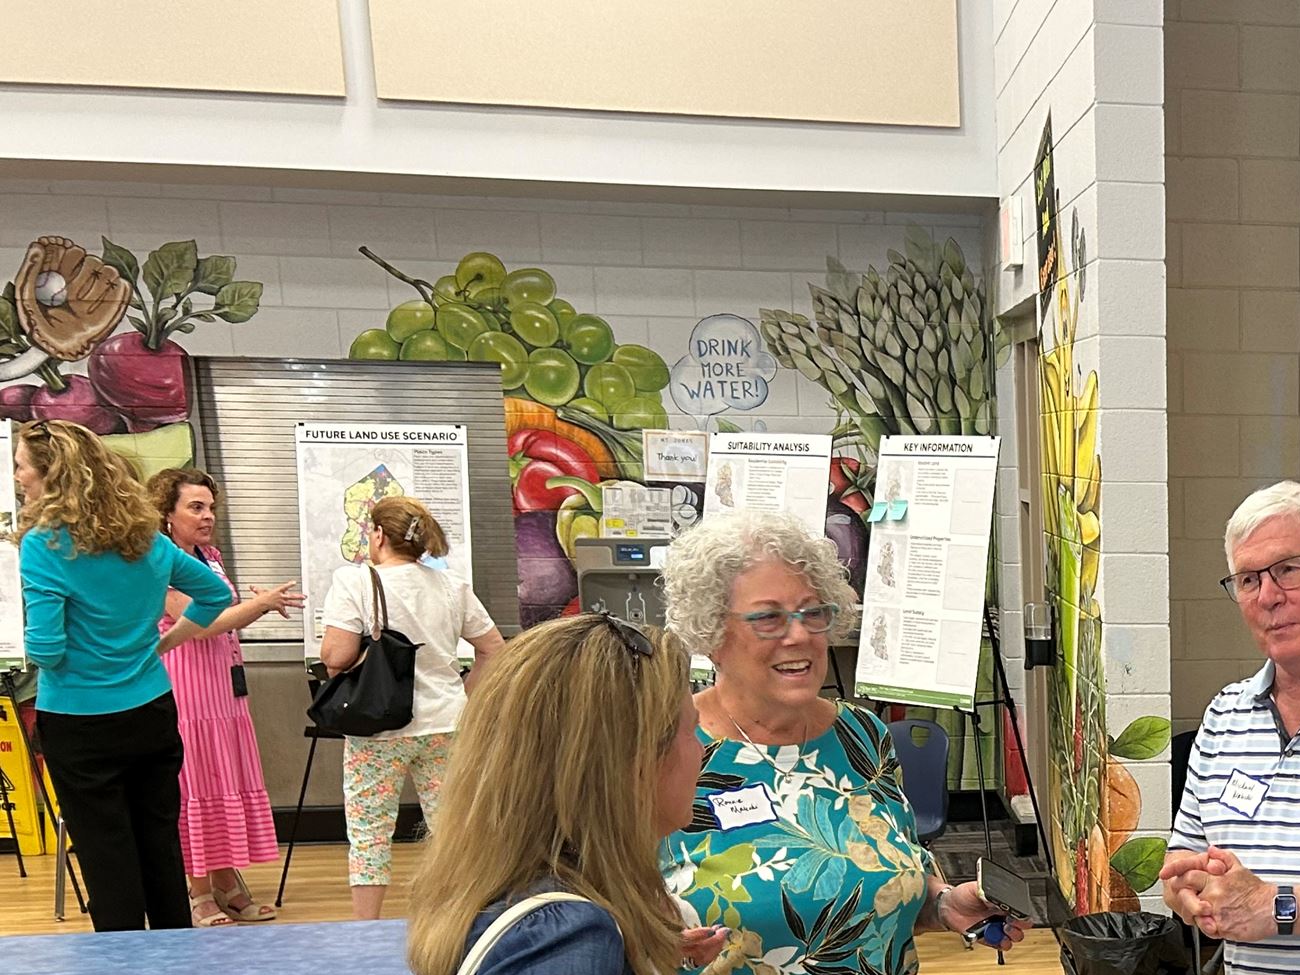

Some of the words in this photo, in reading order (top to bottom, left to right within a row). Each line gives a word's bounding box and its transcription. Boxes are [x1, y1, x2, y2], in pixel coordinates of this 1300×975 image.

[697, 339, 752, 357] DRINK
[702, 362, 746, 378] MORE
[680, 380, 759, 400] WATER!
[306, 430, 346, 439] FUTURE
[350, 431, 378, 440] LAND
[381, 432, 400, 440] USE
[403, 432, 457, 441] SCENARIO
[728, 441, 772, 451] SUITABILITY
[773, 442, 810, 452] ANALYSIS
[904, 443, 919, 452] KEY
[920, 443, 973, 452] INFORMATION
